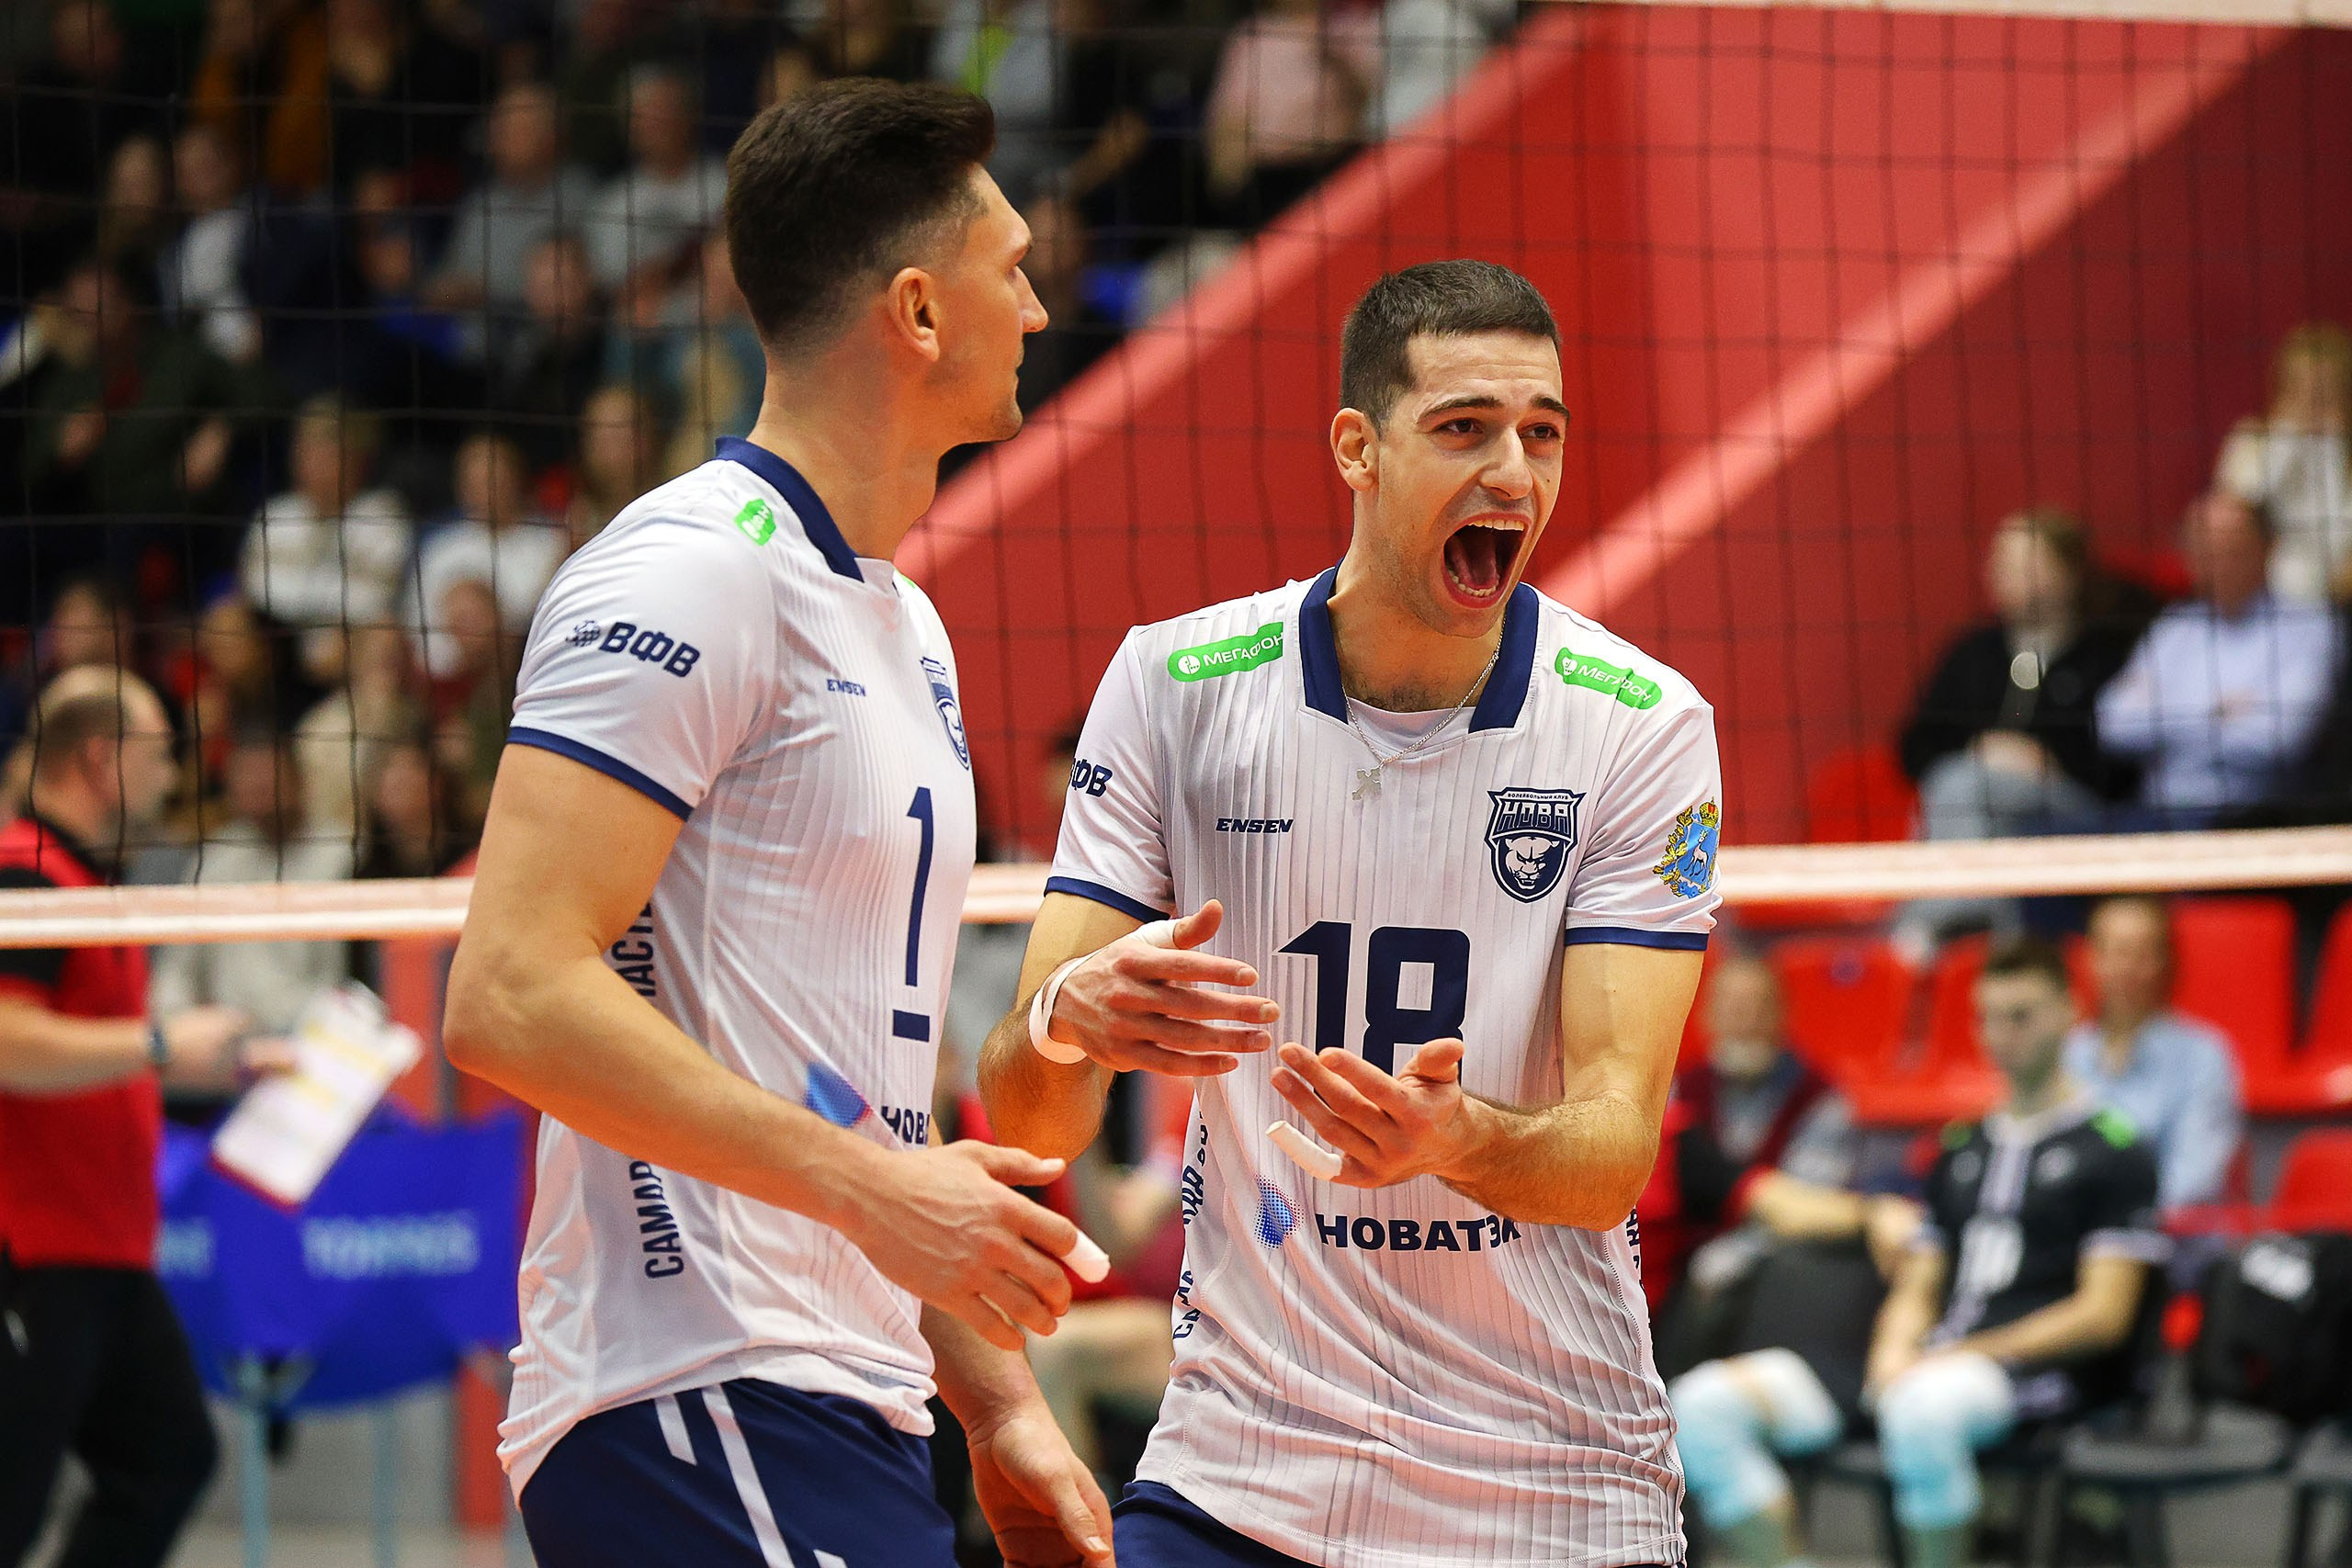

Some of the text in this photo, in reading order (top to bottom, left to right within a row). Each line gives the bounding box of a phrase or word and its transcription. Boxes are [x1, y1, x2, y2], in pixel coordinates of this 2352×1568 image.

[599, 622, 700, 678] ВФВ
[1204, 632, 1283, 667] МЕГАФОН
[1071, 758, 1113, 797] ФВ
[1216, 818, 1294, 833] ENSEN
[1497, 801, 1570, 835] НОВА
[906, 786, 933, 987] 1
[1277, 920, 1470, 1088] 18
